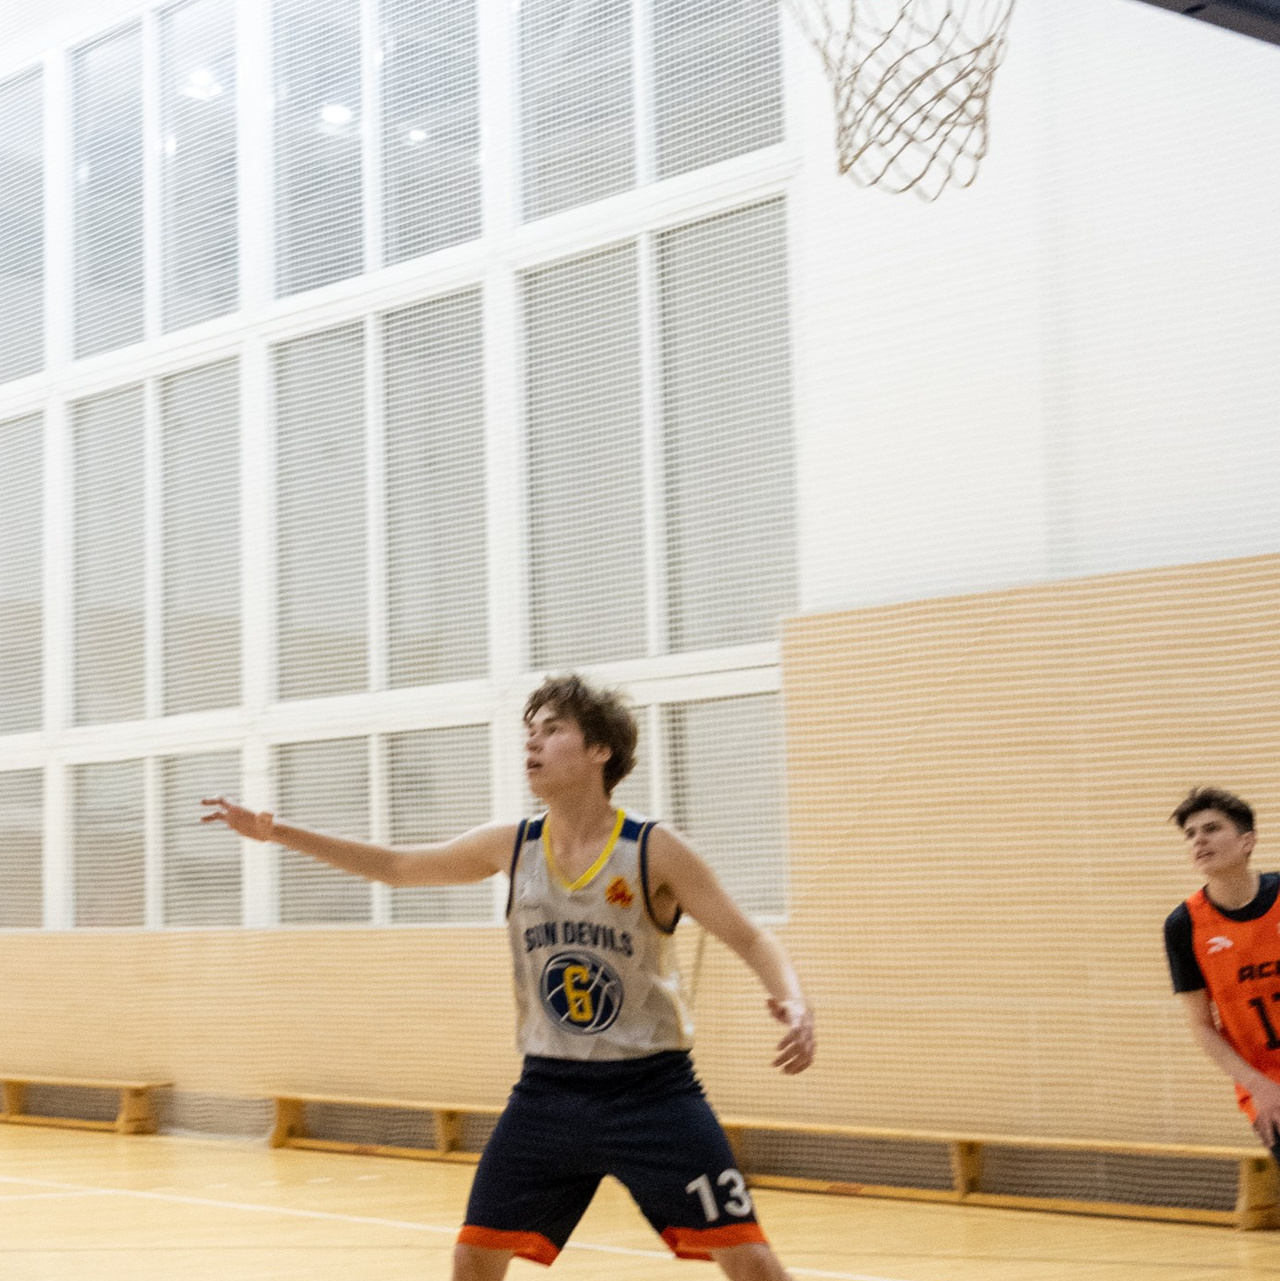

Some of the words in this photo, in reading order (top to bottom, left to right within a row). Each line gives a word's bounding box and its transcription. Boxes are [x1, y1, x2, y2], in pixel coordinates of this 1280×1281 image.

[563, 921, 634, 957] DEVILS
[563, 964, 594, 1023] 6
[685, 1168, 752, 1222] 13
